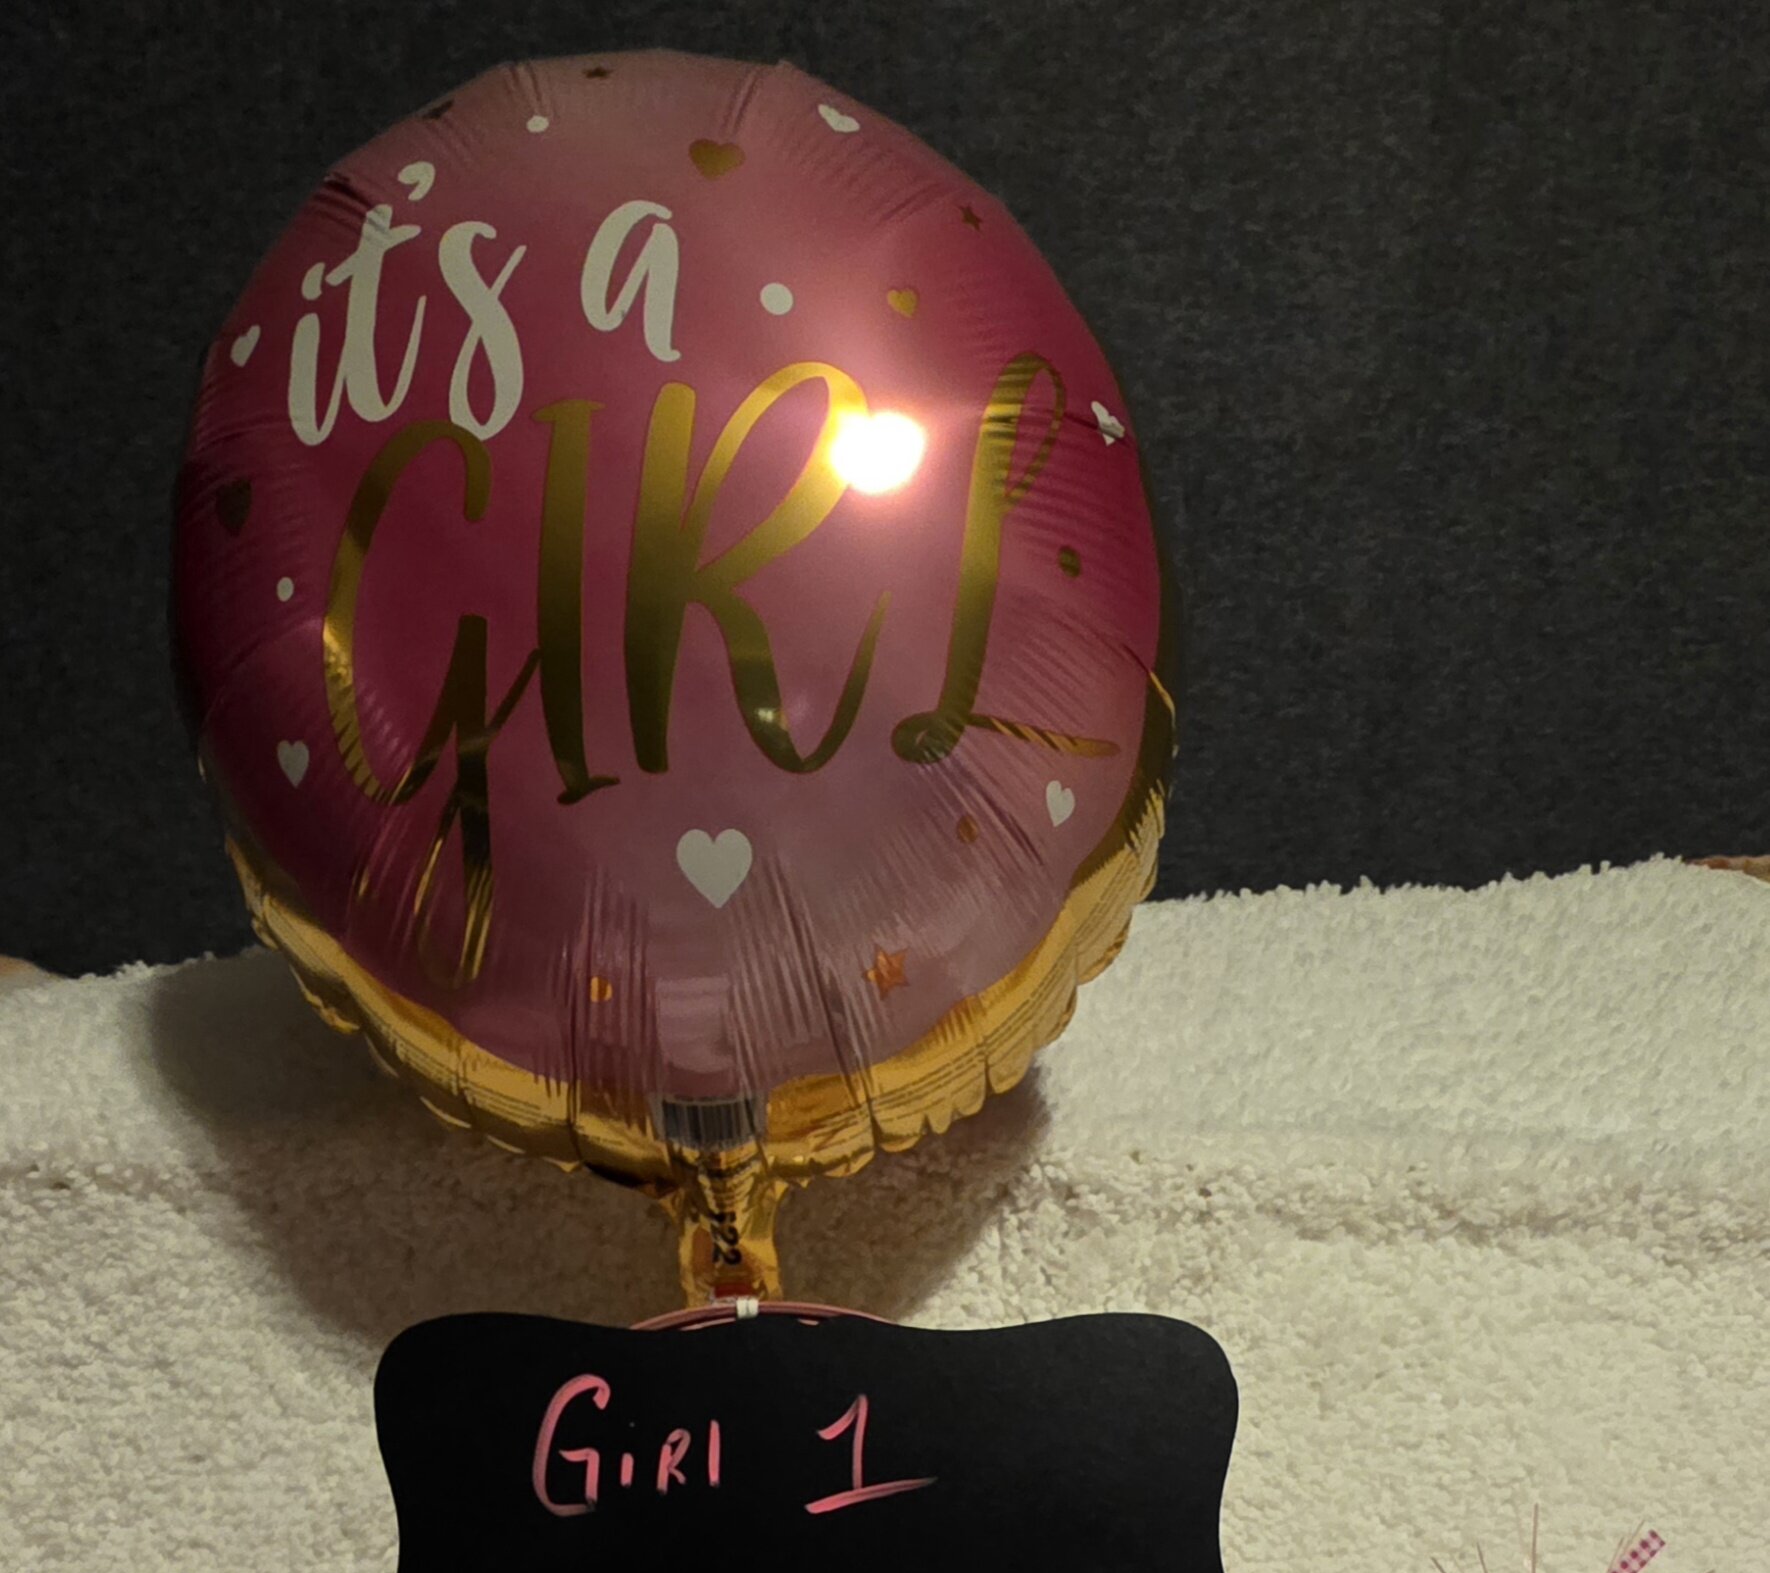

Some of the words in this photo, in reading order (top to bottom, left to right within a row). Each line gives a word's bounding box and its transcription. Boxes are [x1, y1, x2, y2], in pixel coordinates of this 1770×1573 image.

[288, 161, 527, 446] it's
[580, 199, 681, 362] a
[322, 351, 1120, 986] GIRL
[805, 1394, 938, 1514] 1
